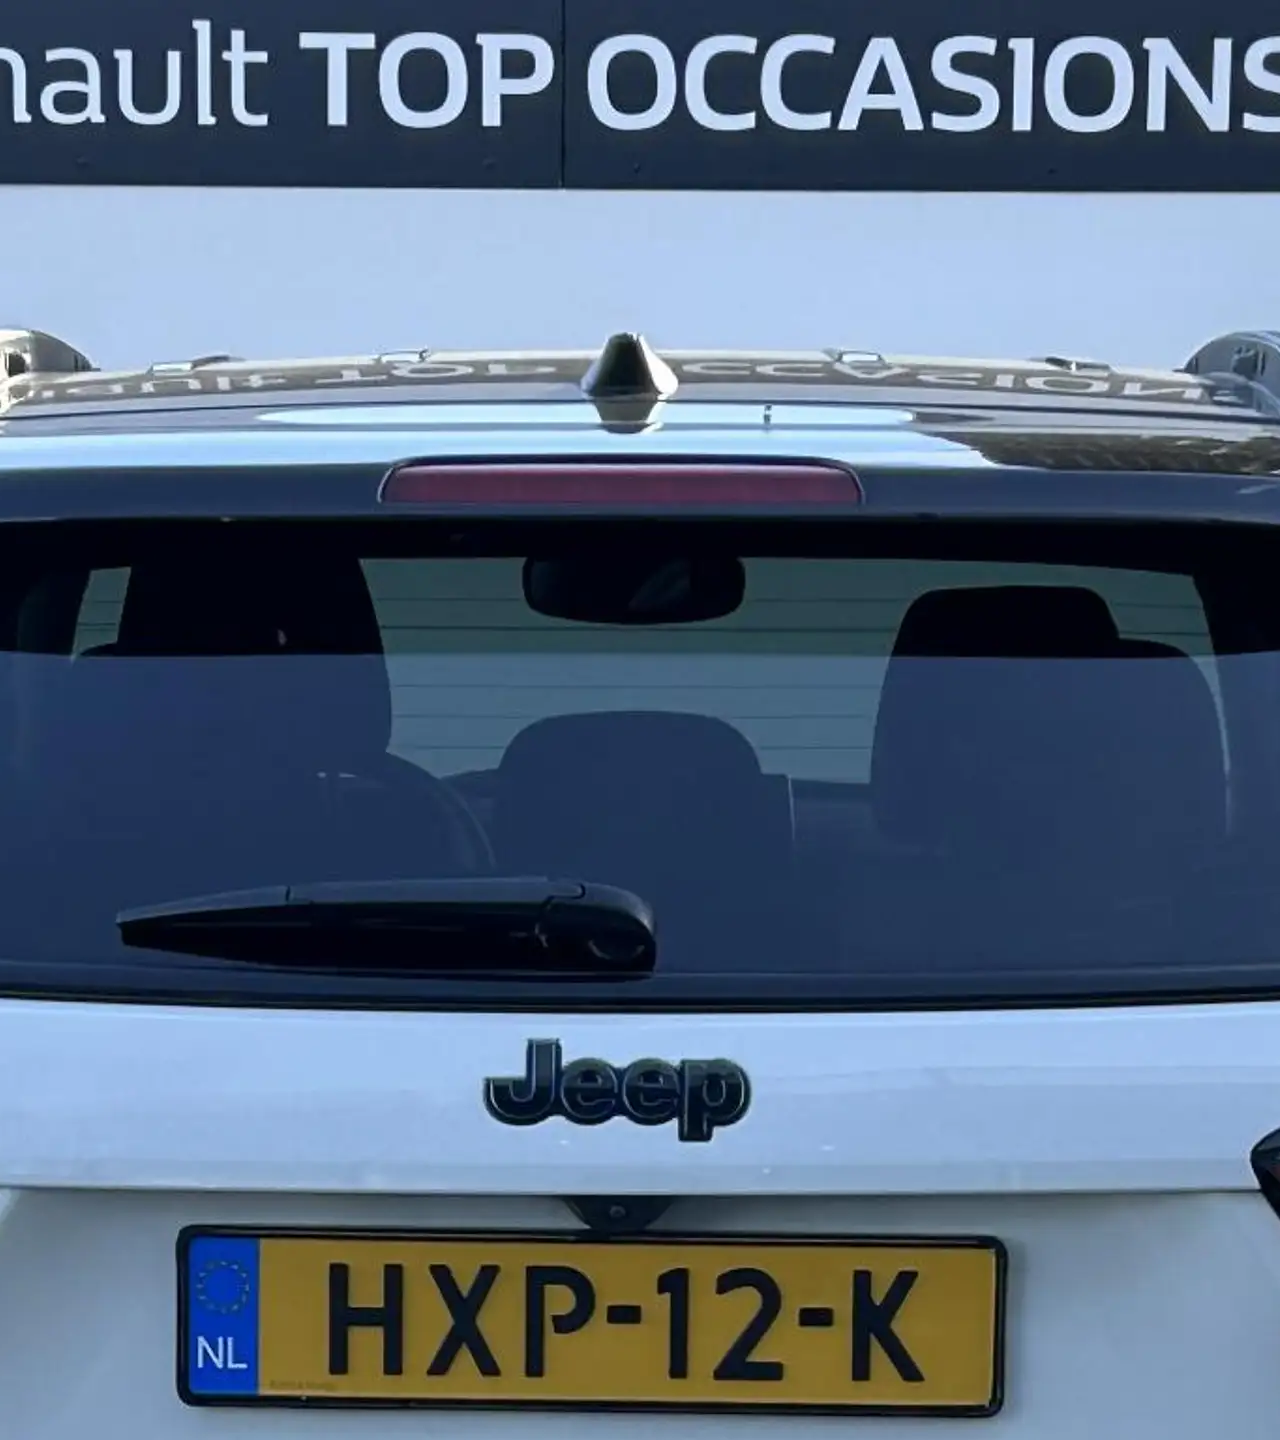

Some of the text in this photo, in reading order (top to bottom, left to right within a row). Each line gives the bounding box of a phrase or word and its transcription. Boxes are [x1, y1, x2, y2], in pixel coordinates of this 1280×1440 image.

[299, 31, 556, 129] TOP
[483, 1038, 751, 1142] Jeep
[197, 1335, 248, 1369] NL
[327, 1262, 925, 1383] HXP-12-K
